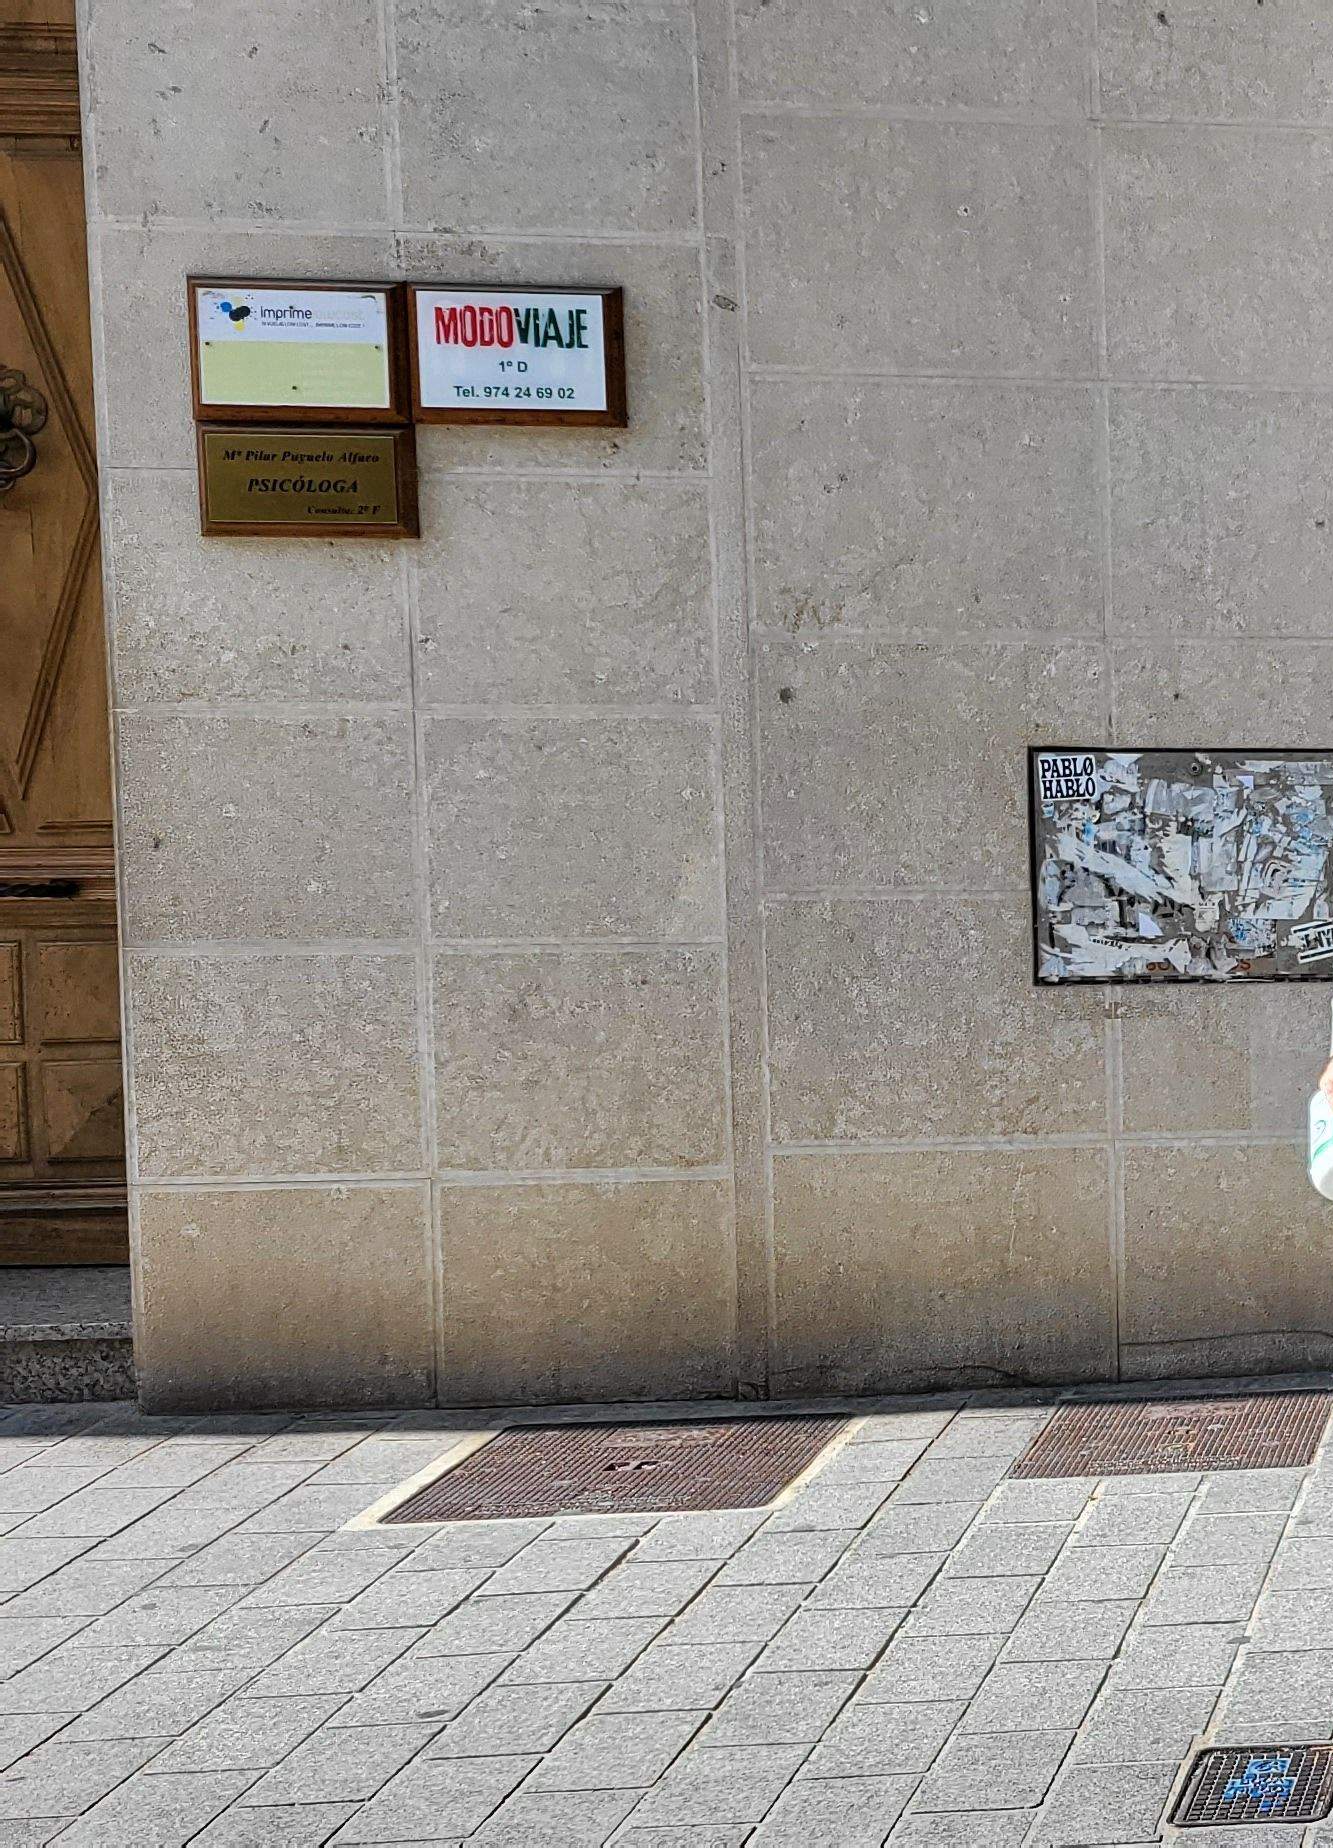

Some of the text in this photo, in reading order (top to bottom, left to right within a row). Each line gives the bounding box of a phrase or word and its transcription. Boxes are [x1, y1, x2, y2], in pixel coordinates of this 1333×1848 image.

[434, 305, 588, 349] MODOVIAJE
[517, 361, 528, 373] D
[454, 386, 575, 400] Tel. 974 24 69 02
[246, 450, 277, 462] Pilar
[248, 475, 358, 494] PSICÓLOGA
